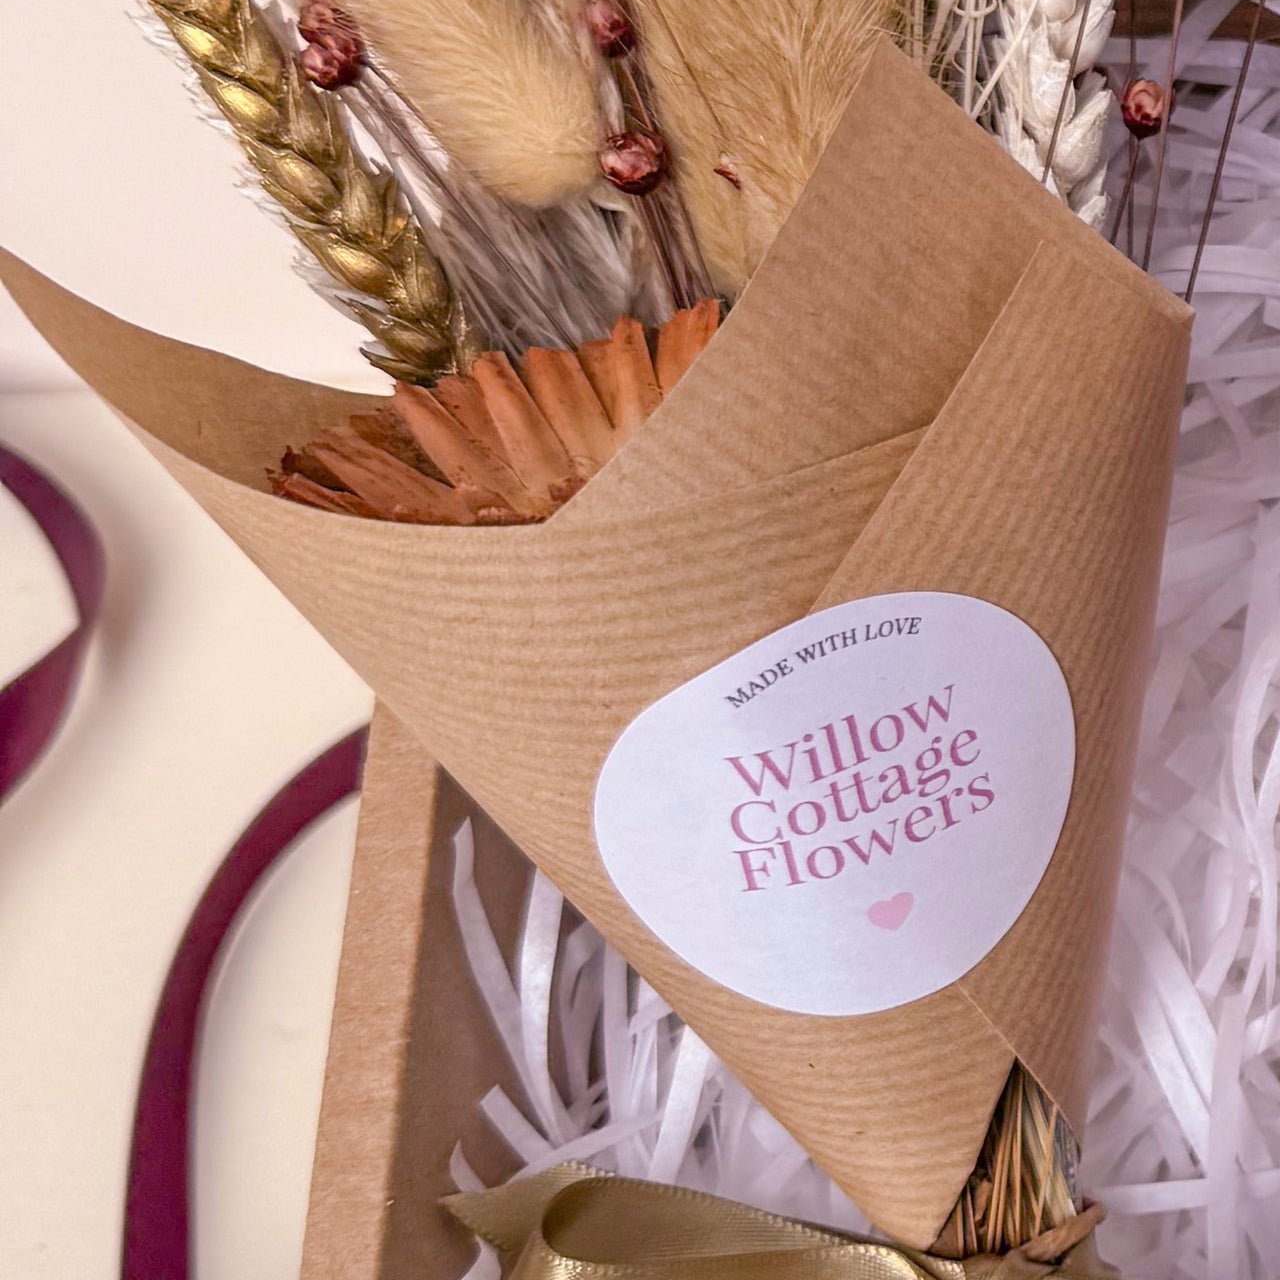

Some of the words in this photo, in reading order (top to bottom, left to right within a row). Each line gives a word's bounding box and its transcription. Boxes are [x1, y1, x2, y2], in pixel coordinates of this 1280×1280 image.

[724, 658, 794, 709] MADE
[794, 627, 858, 665] WITH
[864, 616, 922, 642] LOVE
[723, 683, 956, 797] Willow
[729, 728, 982, 845] Cottage
[732, 771, 996, 892] Flowers
